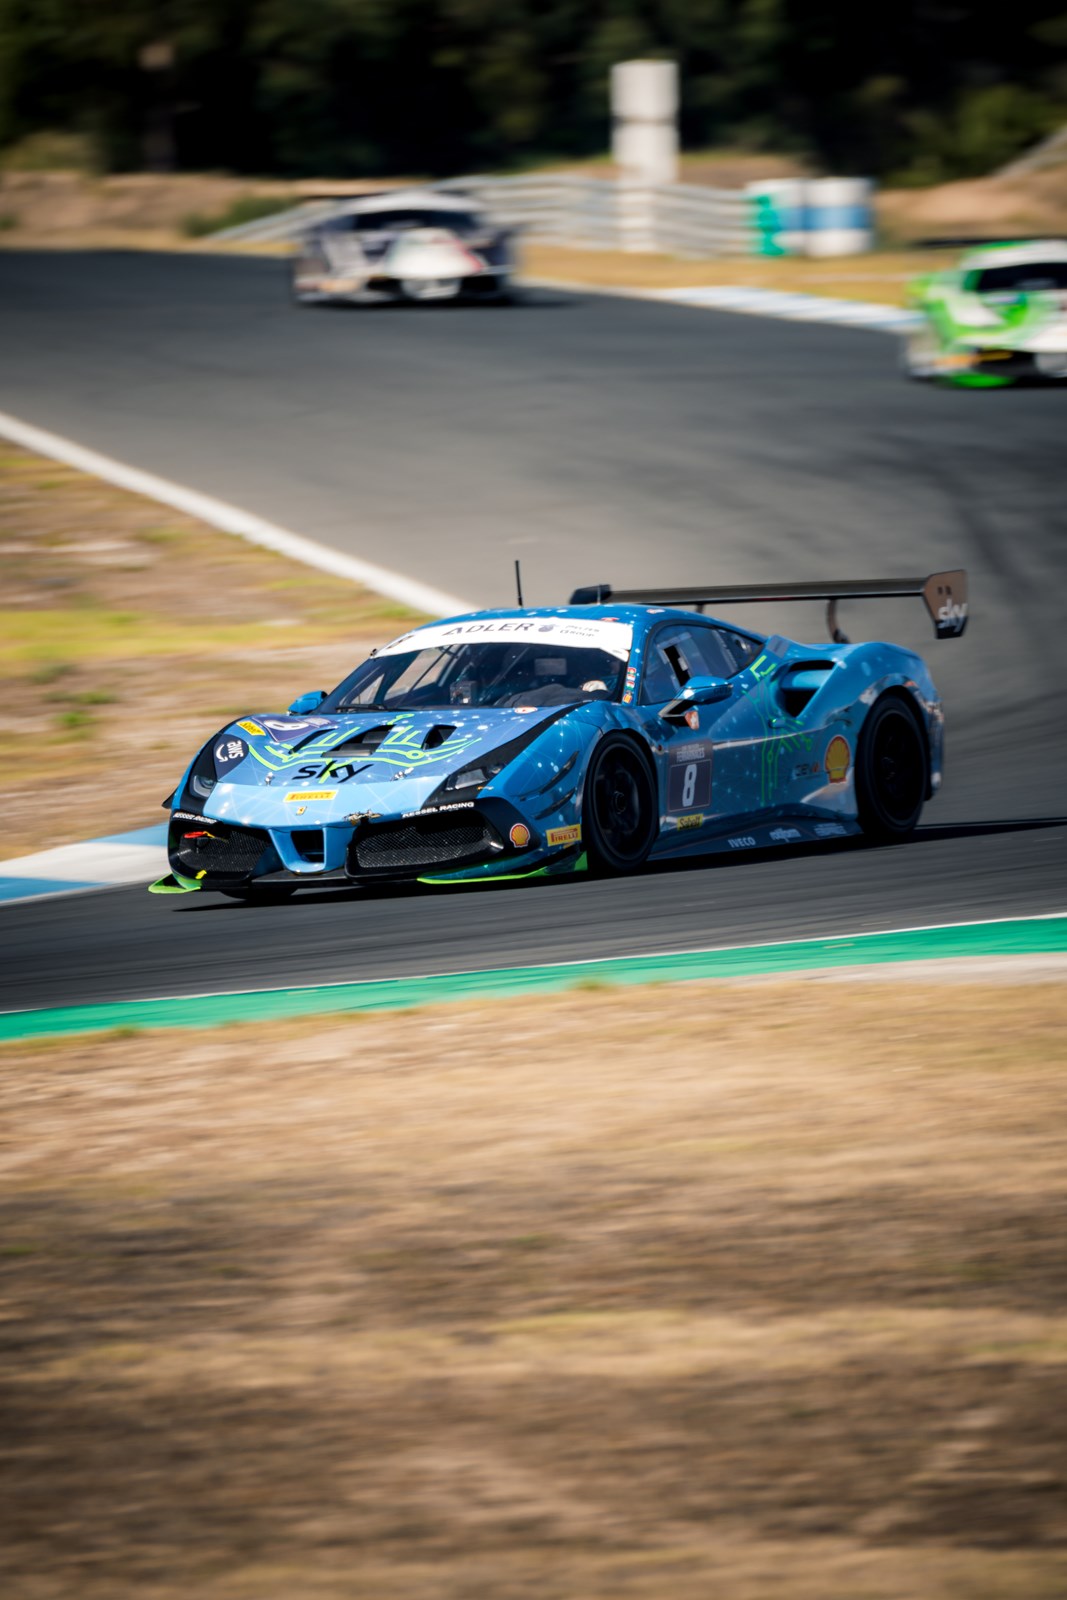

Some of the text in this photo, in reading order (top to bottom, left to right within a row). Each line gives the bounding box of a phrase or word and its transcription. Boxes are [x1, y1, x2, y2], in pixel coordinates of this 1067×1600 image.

[442, 621, 536, 637] ADLER
[292, 760, 374, 784] sky
[681, 763, 698, 807] 8
[439, 801, 475, 812] RACING
[550, 827, 578, 843] PIRELLI
[727, 836, 756, 848] IVECO
